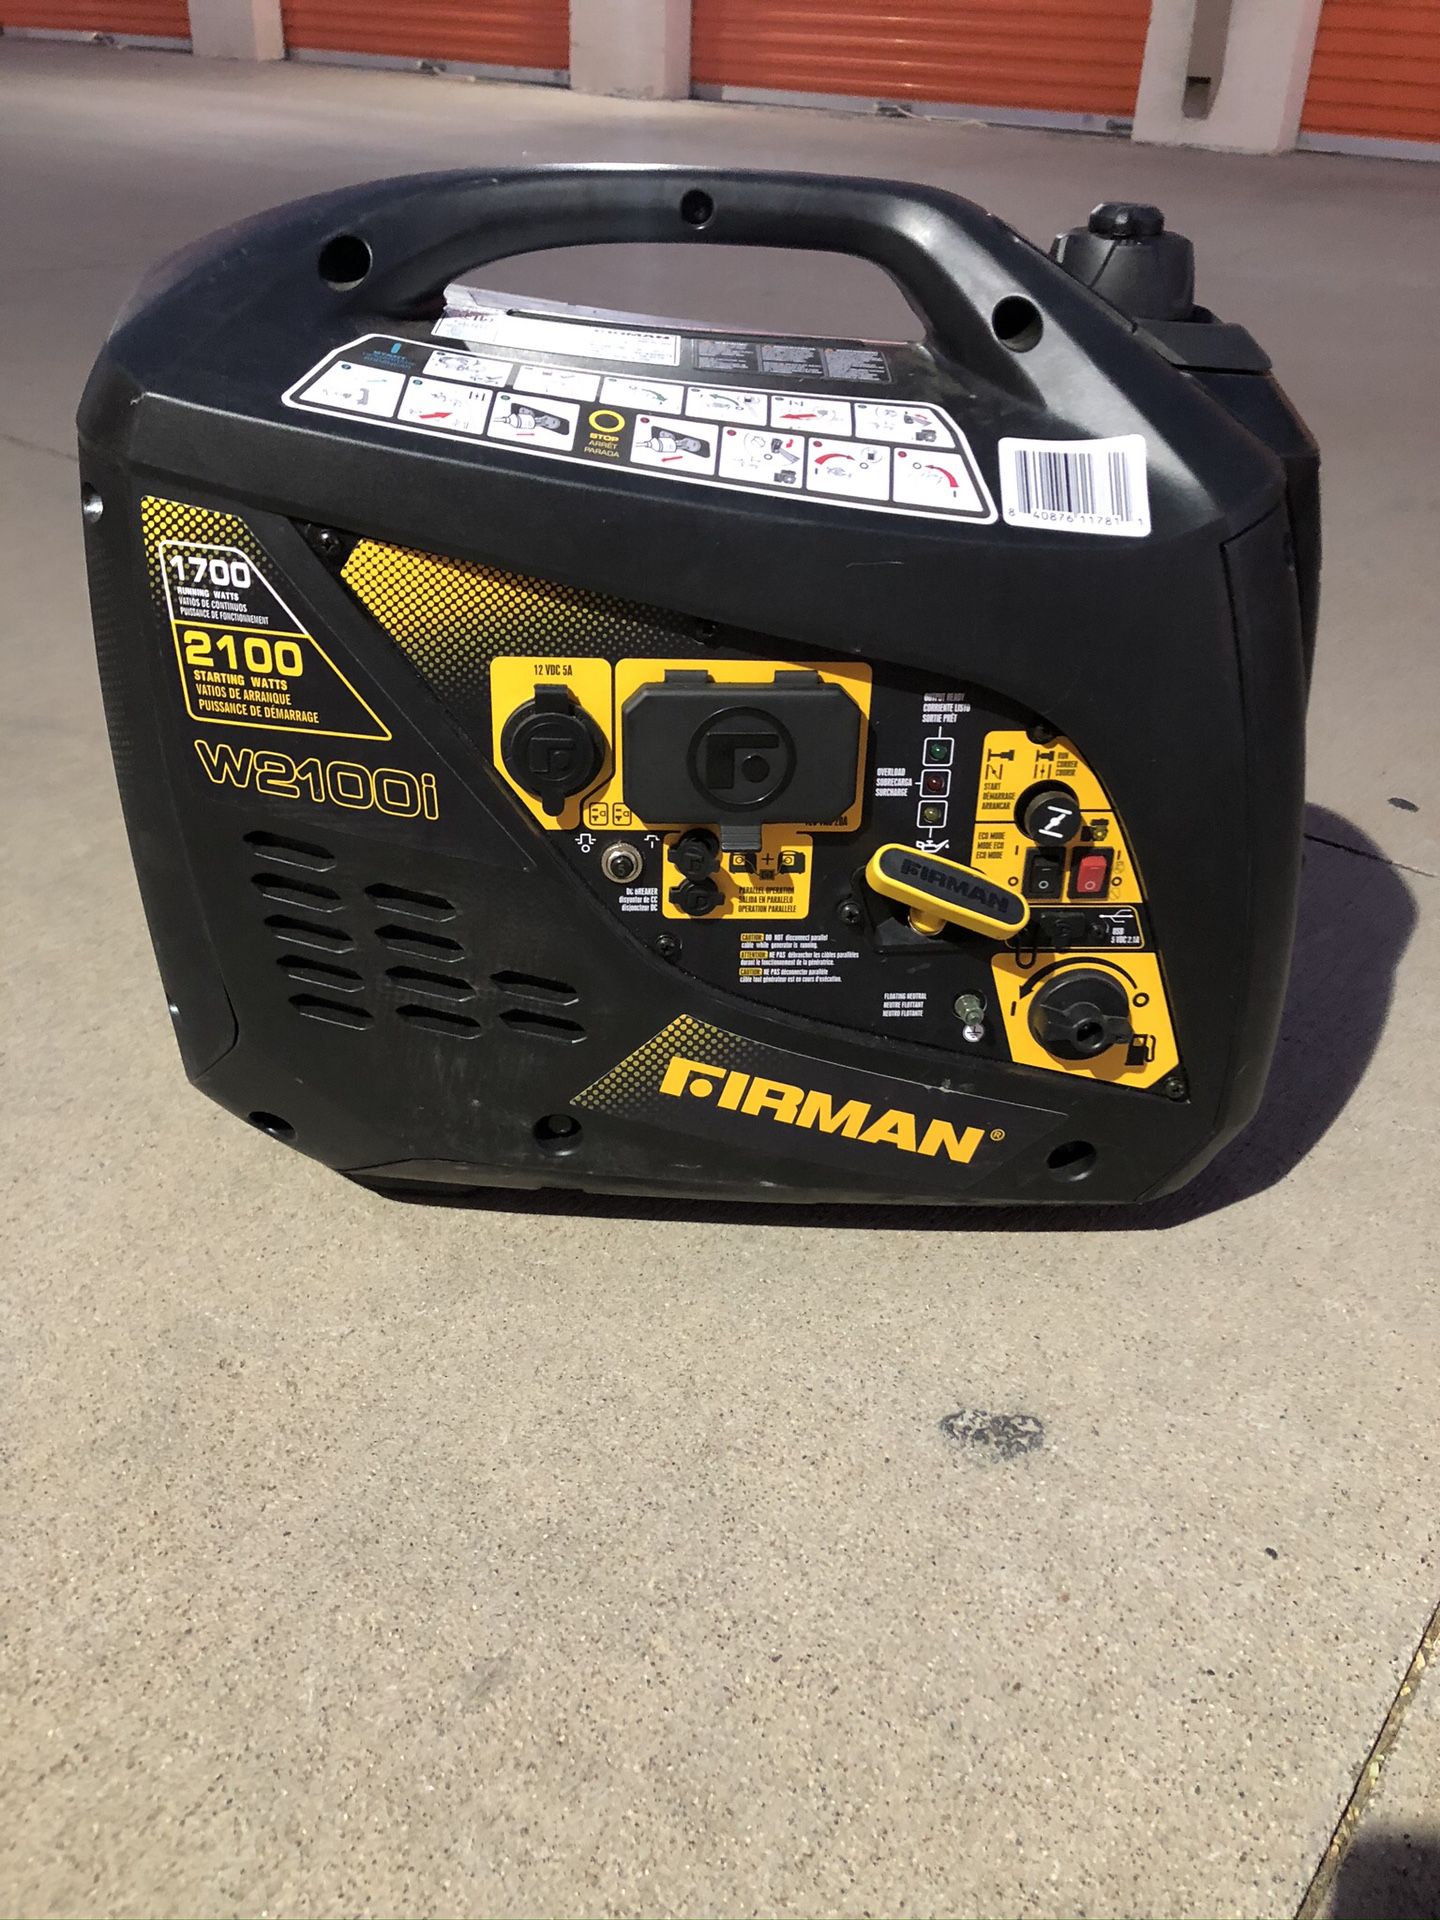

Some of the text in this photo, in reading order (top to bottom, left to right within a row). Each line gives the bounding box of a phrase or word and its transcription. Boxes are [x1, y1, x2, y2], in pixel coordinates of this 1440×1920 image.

[590, 432, 619, 442] STOP
[583, 446, 620, 458] PARADA
[1033, 511, 1074, 523] 40876
[170, 555, 251, 589] 1700
[177, 586, 240, 601] RUNNING WATTS
[178, 596, 248, 613] VATIOS DE CONTINUOS
[180, 606, 210, 619] PUISSANCE
[211, 610, 219, 620] DE
[184, 630, 303, 677] 2100
[534, 664, 573, 676] 12 VDC 5A
[193, 669, 288, 691] STARTING WATTS
[196, 683, 292, 706] VATIOS DE ARRANQUE
[199, 699, 320, 724] PUISSANCE DE DÉMARRAGE
[194, 739, 440, 820] W2100i
[877, 768, 906, 777] OVERLOAD
[984, 782, 1001, 790] START
[979, 832, 1005, 840] ECO MODE
[977, 841, 1004, 849] MODE ECO
[976, 851, 1003, 859] ECO MODE
[901, 858, 1009, 913] FIRMAN
[659, 1056, 986, 1164] FIRMAN
